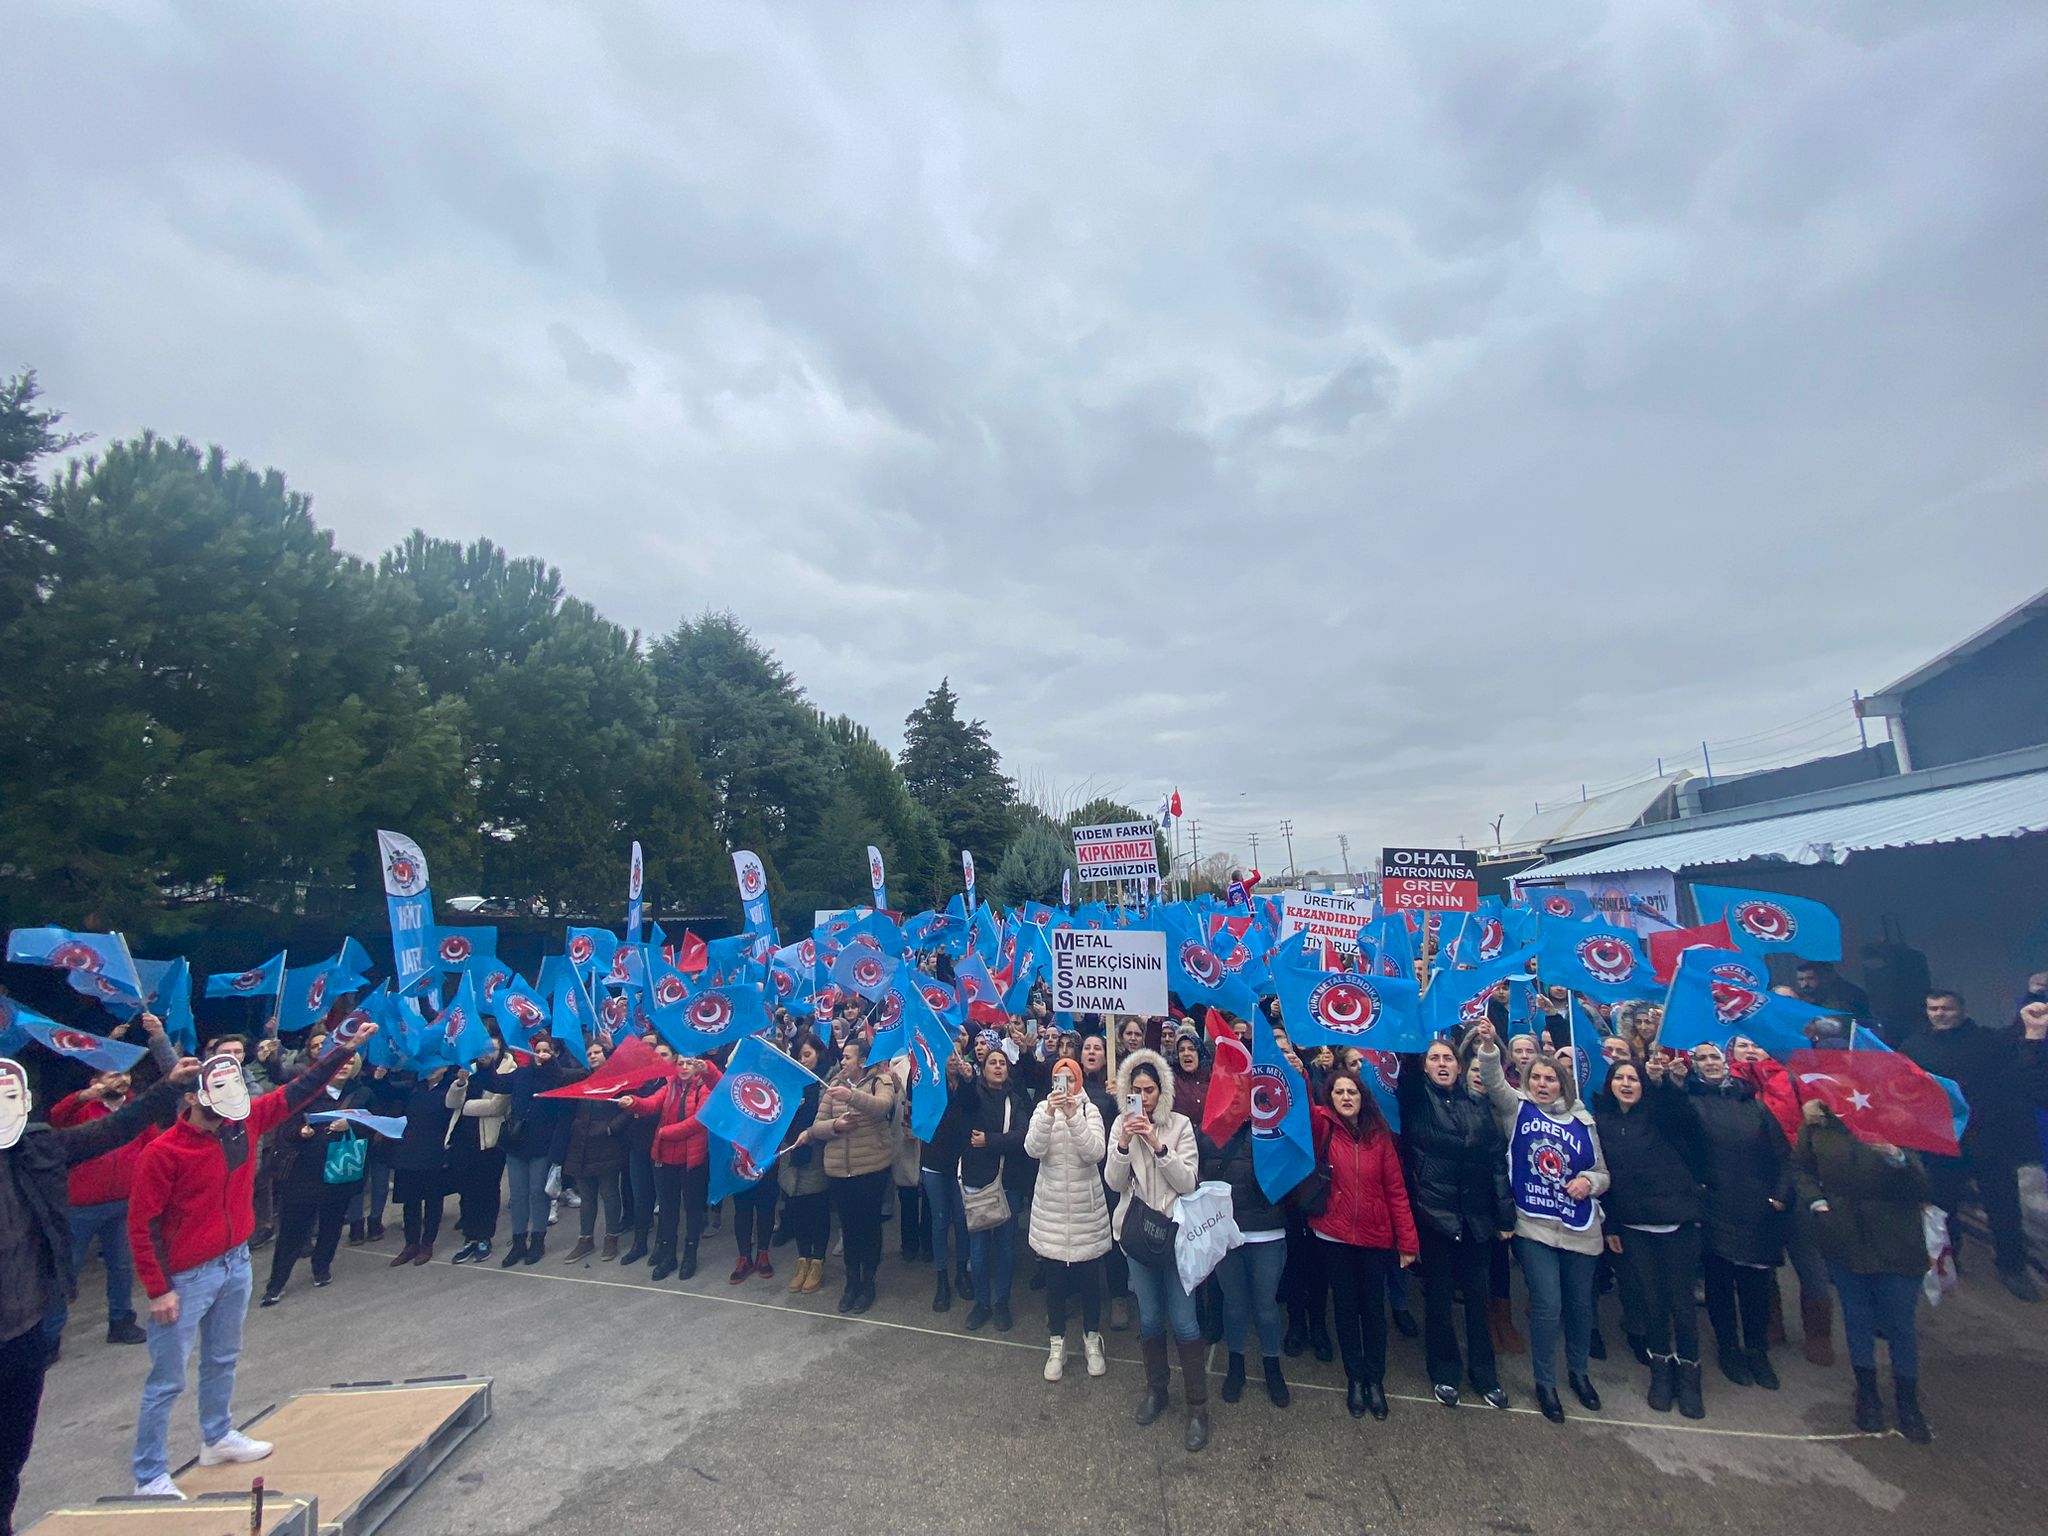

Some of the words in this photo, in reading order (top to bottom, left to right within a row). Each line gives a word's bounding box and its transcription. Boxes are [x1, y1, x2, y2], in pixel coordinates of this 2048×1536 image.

[1073, 828, 1112, 840] KIDEM
[1116, 825, 1153, 837] FARKI
[1078, 842, 1153, 862] KIPKIRMIZI
[1393, 852, 1465, 866] OHAL
[1080, 862, 1157, 880] ÇİZGİMİZDİR
[1385, 866, 1475, 879] PATRONUNSA
[1403, 880, 1456, 893] GREV
[1304, 893, 1355, 911] ÜRETTİK
[1395, 891, 1463, 907] İŞÇİNİN
[1055, 933, 1112, 951] METAL
[1057, 952, 1161, 972] EMEKÇİSİNİN
[1057, 971, 1127, 990] SABRINI
[1316, 975, 1345, 994] METAL
[1057, 990, 1126, 1011] SINAMA
